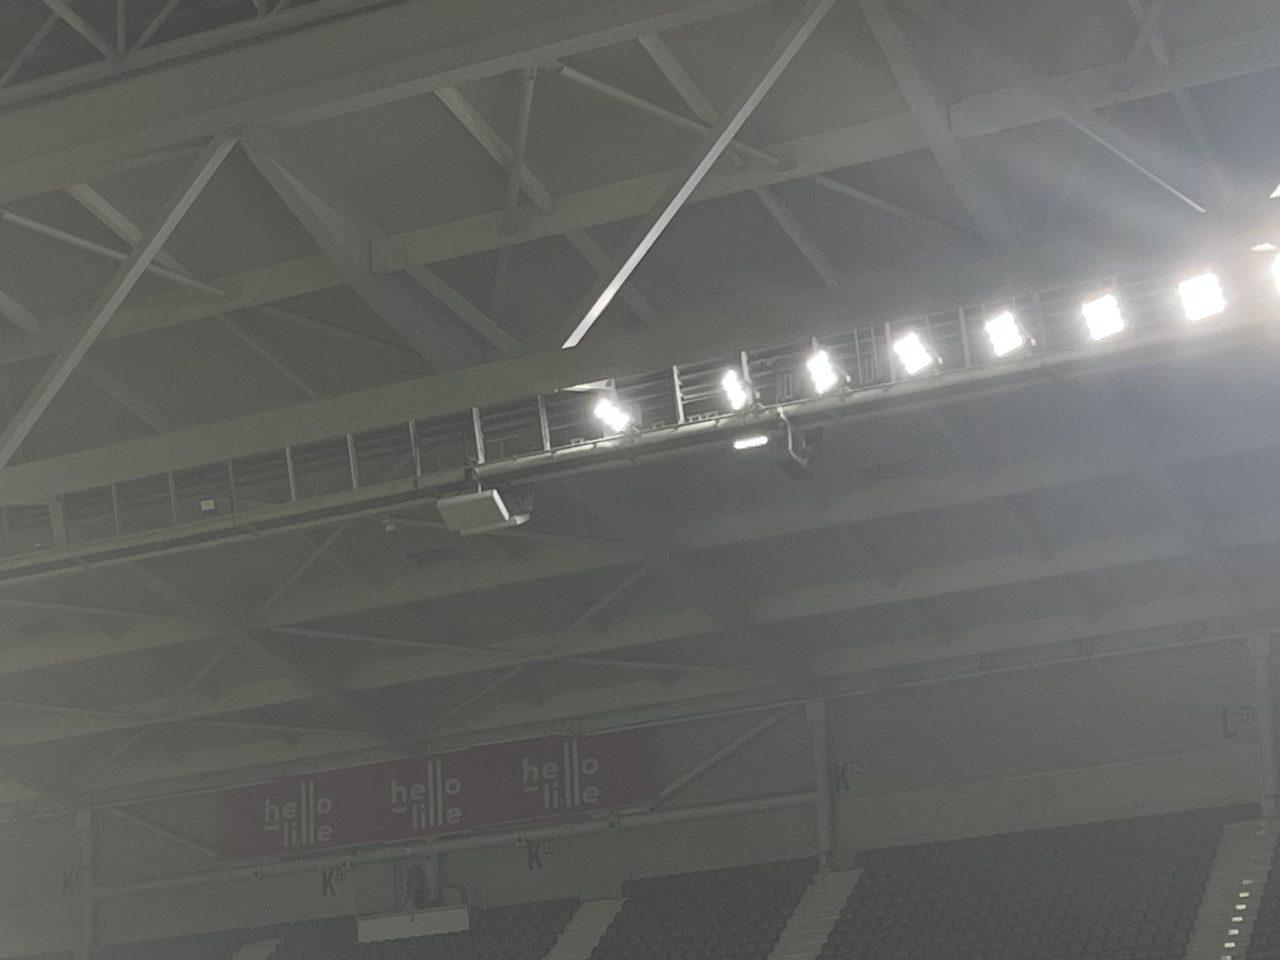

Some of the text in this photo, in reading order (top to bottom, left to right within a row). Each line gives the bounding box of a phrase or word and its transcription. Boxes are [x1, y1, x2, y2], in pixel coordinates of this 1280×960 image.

[391, 761, 462, 805] hello
[523, 740, 599, 784] hello
[265, 780, 333, 823] hello
